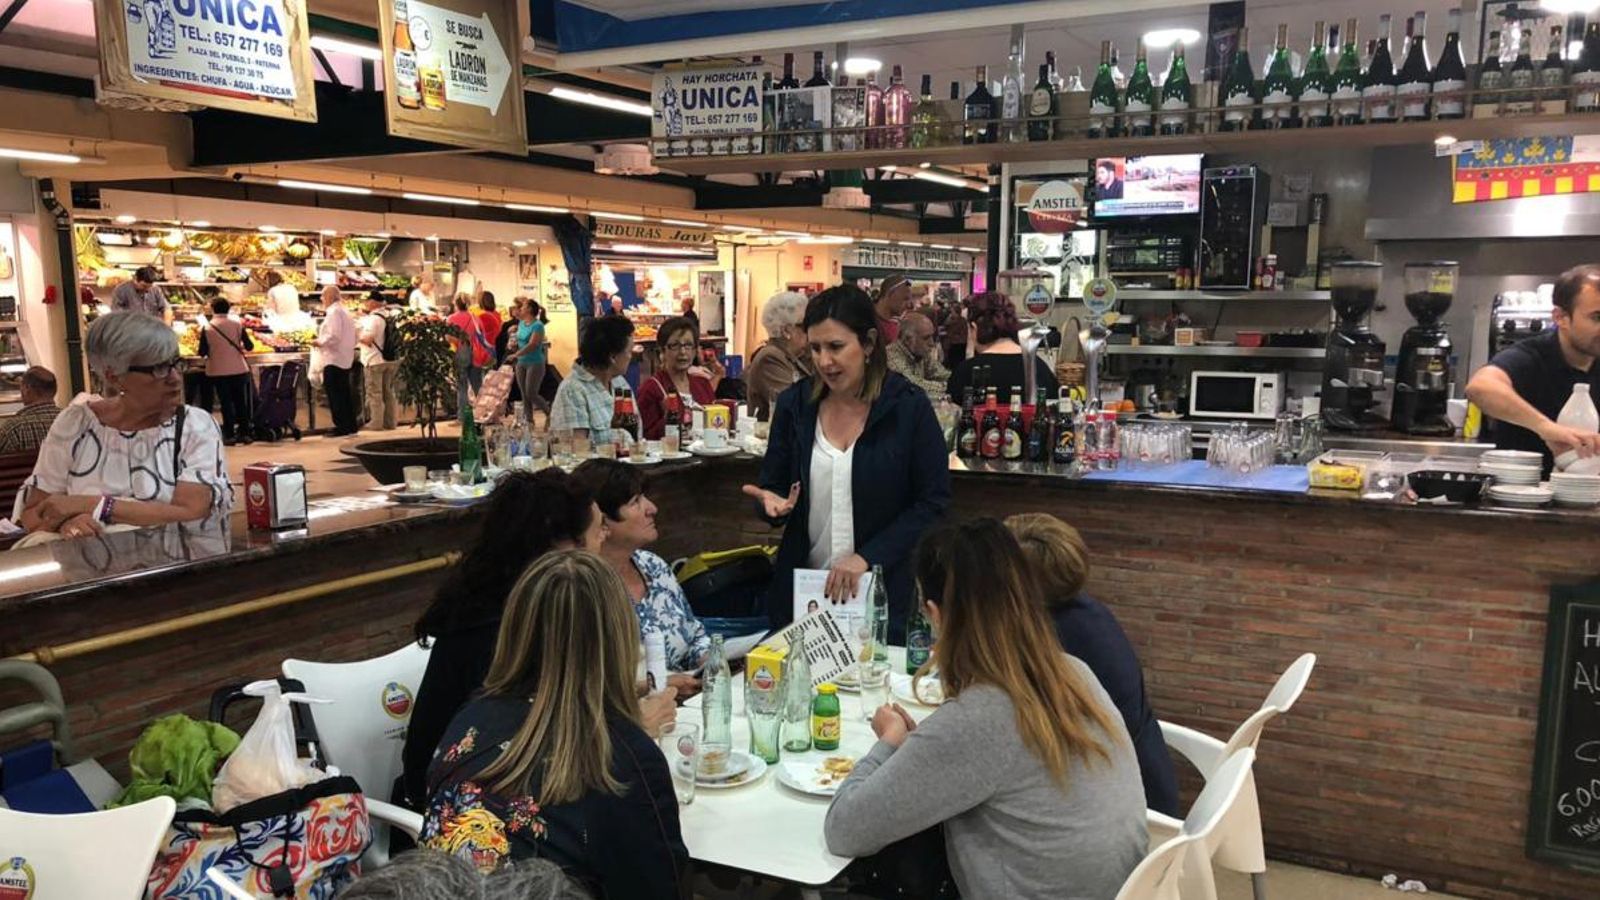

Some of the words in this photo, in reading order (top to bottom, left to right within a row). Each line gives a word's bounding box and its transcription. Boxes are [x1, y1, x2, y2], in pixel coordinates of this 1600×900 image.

[445, 19, 456, 34] SE
[458, 22, 484, 41] BUSCA
[179, 24, 211, 43] TEL.:
[214, 31, 235, 48] 657
[239, 38, 259, 53] 277
[263, 42, 283, 57] 169
[188, 46, 207, 56] PLAZA
[209, 50, 220, 60] DEL
[134, 63, 199, 82] INGREDIENTES:
[201, 74, 228, 86] CHUFA
[233, 80, 255, 91] AGUA
[451, 70, 459, 82] DE
[682, 75, 703, 85] HAY
[704, 71, 758, 84] HORCHATA
[707, 114, 722, 125] 657
[725, 113, 740, 124] 277
[742, 113, 758, 123] 169
[1033, 198, 1078, 209] AMSTEL
[596, 222, 662, 239] ERDURAS
[669, 229, 707, 242] Javi
[858, 246, 899, 267] FRUTAS
[902, 249, 909, 268] Y
